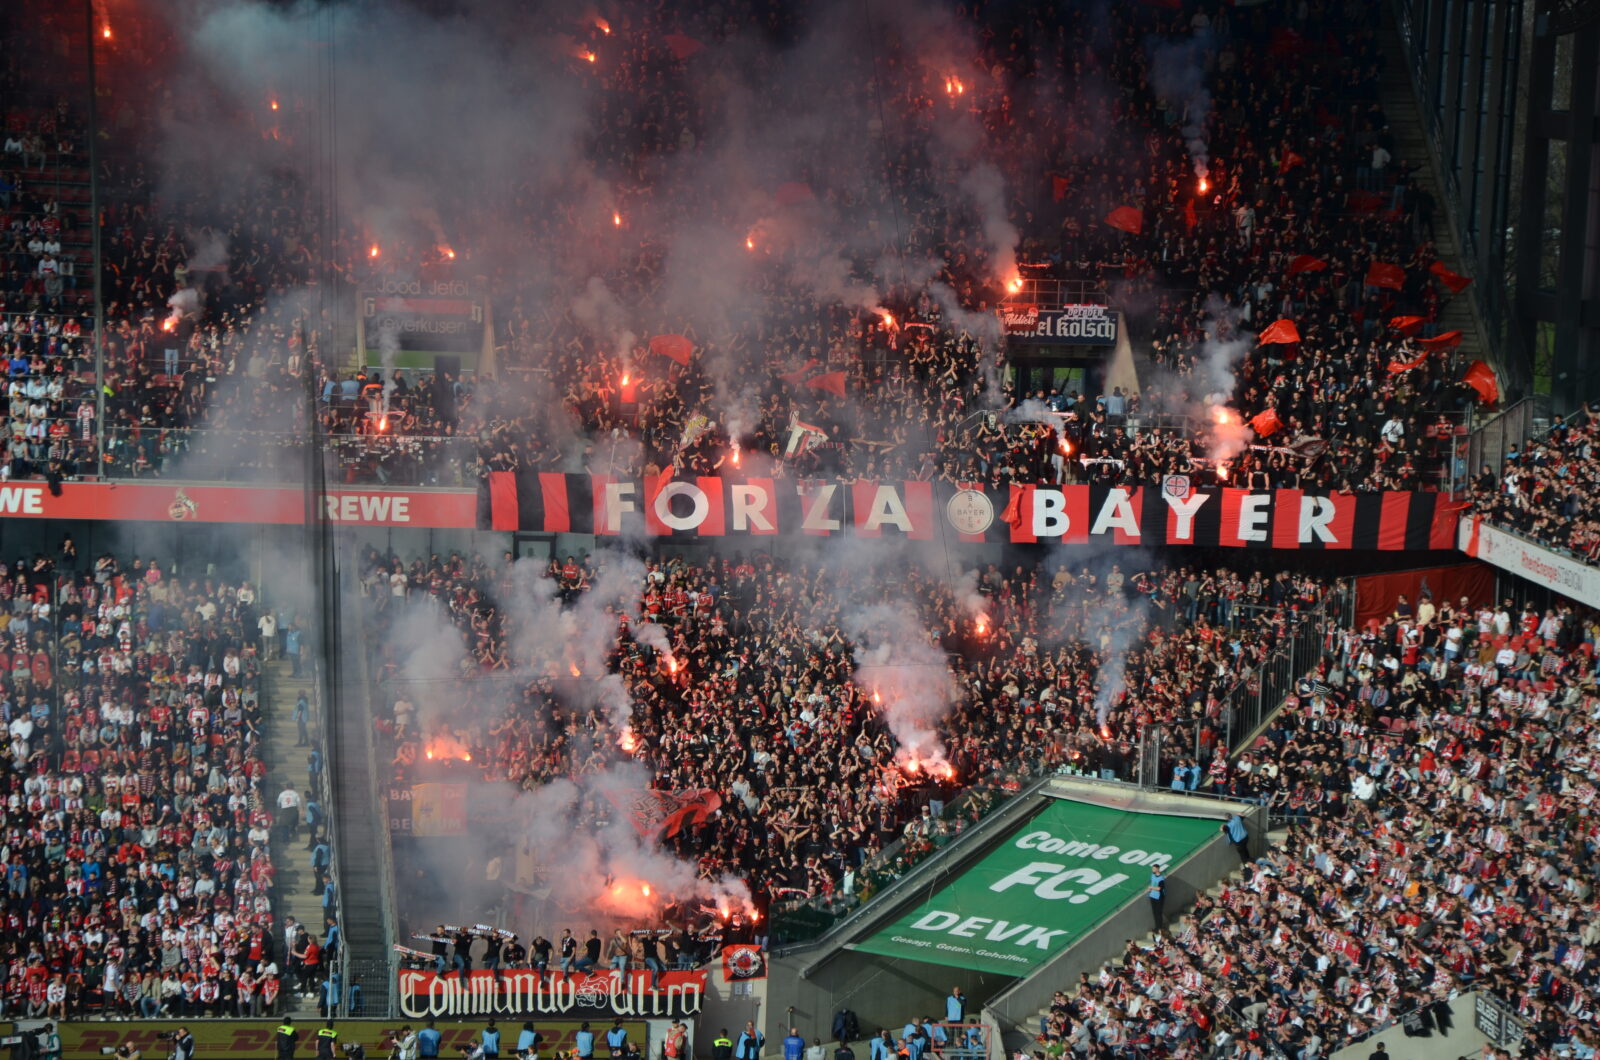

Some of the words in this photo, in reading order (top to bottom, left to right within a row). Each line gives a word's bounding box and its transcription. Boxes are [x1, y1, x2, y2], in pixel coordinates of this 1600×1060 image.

[376, 279, 421, 295] Jood
[317, 495, 411, 522] REWE
[605, 481, 914, 532] FORZA
[1032, 488, 1339, 543] BAYER
[1015, 831, 1120, 860] Come
[989, 861, 1130, 905] FC!
[891, 935, 932, 948] Gesagt.
[936, 943, 971, 954] Getan.
[975, 949, 1030, 964] Geholfen.
[910, 910, 1069, 951] DEVK
[400, 971, 576, 1019] Commando
